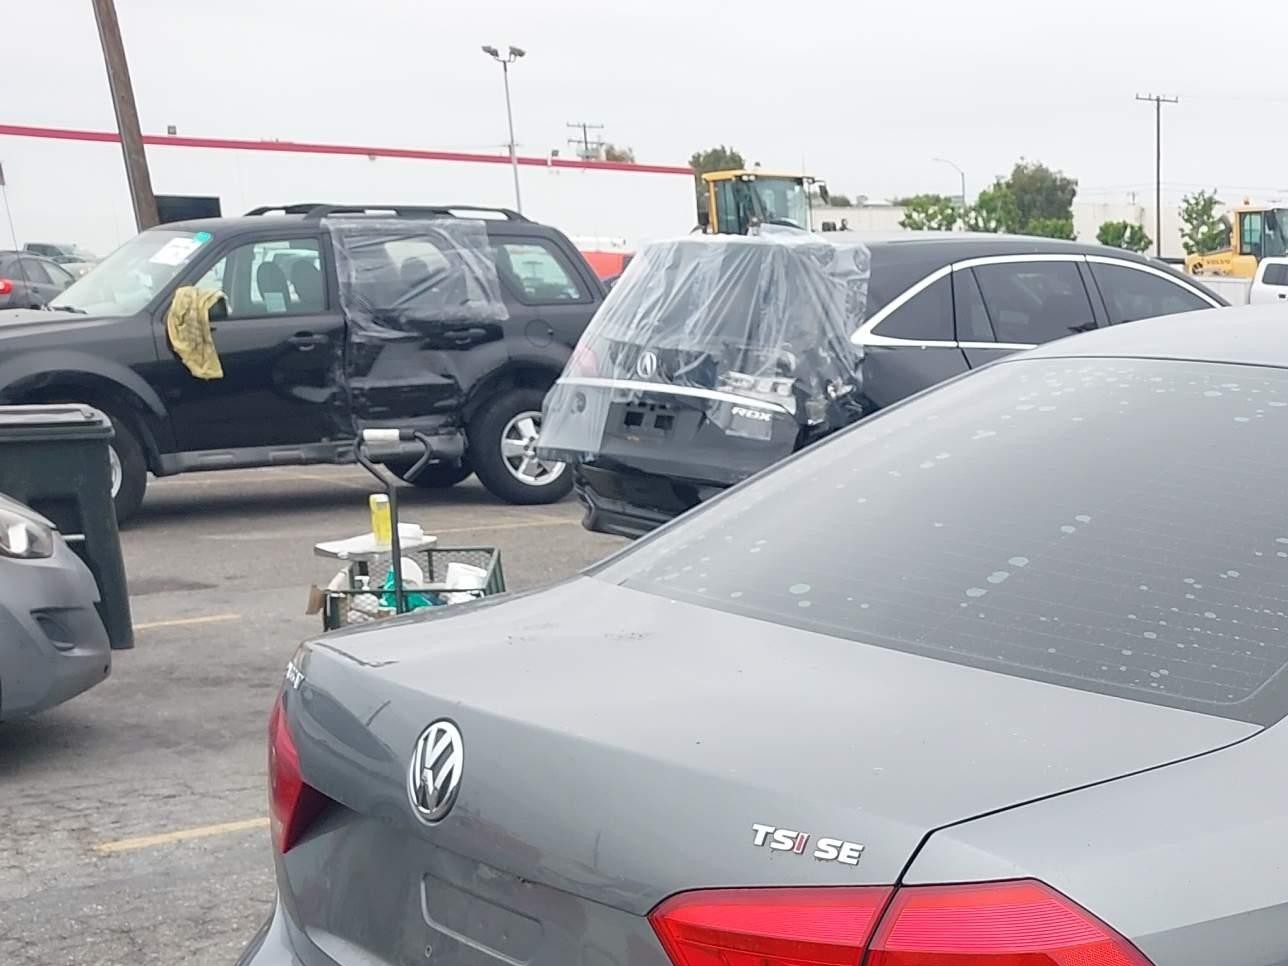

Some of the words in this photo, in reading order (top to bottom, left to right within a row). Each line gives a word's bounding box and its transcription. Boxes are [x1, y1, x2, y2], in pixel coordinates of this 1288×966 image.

[731, 406, 772, 421] RDX
[752, 823, 810, 854] TSI
[813, 837, 865, 866] SE
